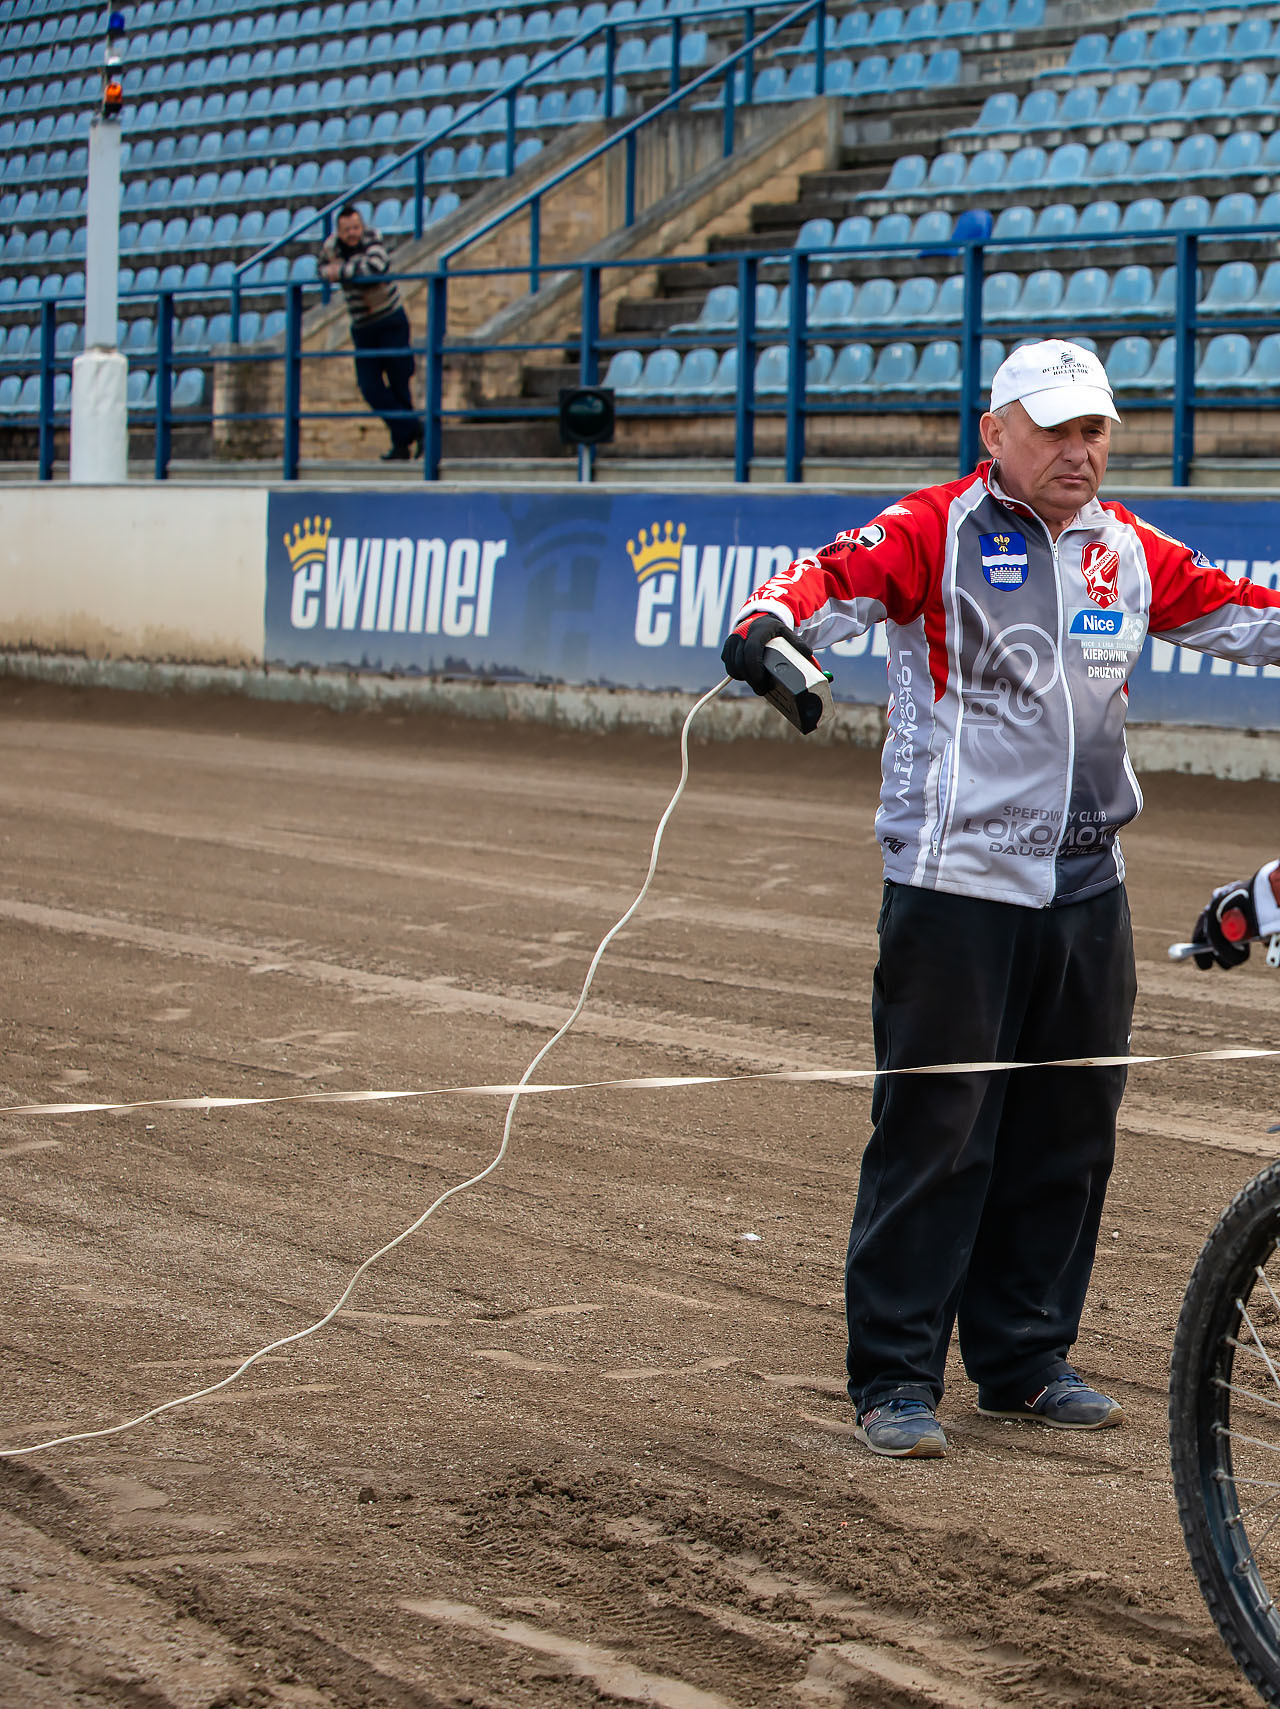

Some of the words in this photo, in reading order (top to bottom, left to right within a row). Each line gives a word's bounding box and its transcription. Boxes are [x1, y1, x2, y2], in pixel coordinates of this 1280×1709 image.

[1083, 614, 1115, 632] Nice
[1083, 647, 1129, 662] KIEROWNIK
[895, 649, 919, 808] LOKOMOTIV
[1079, 810, 1108, 823] CLUB
